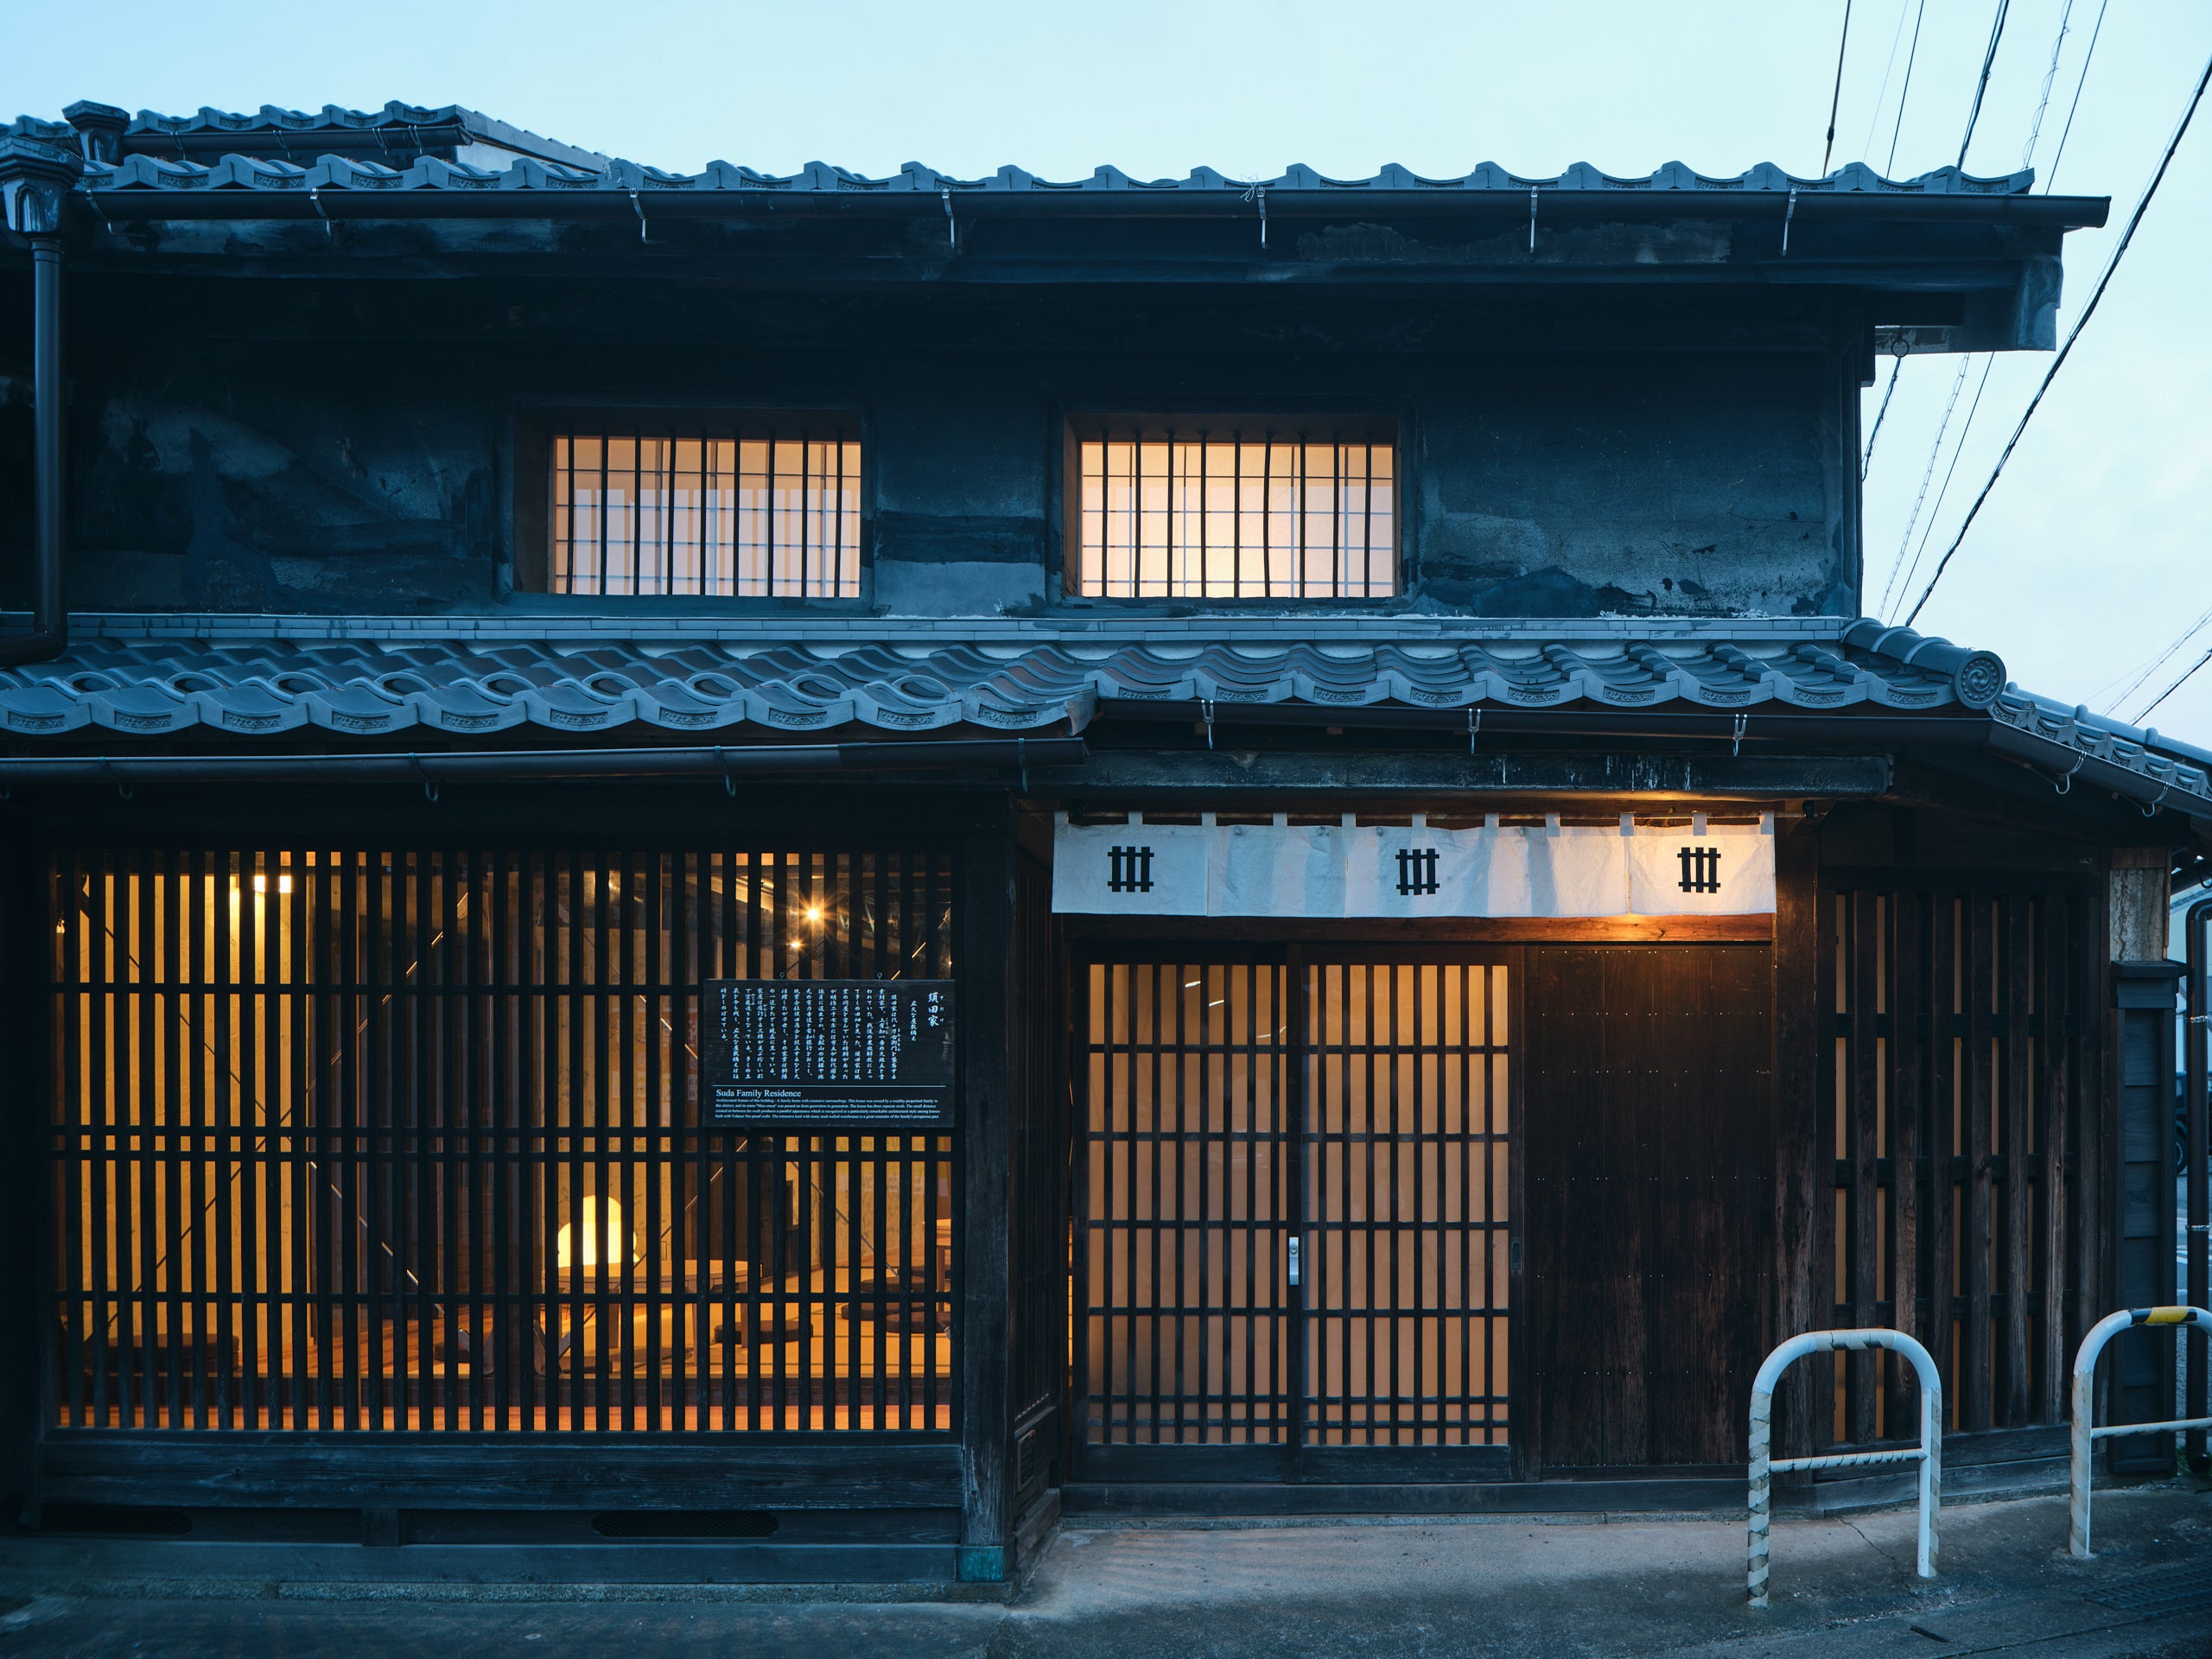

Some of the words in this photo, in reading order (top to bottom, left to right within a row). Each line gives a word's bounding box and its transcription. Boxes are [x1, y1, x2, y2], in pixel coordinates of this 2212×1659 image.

[927, 992, 938, 1027] 須田家
[737, 1090, 762, 1098] Family
